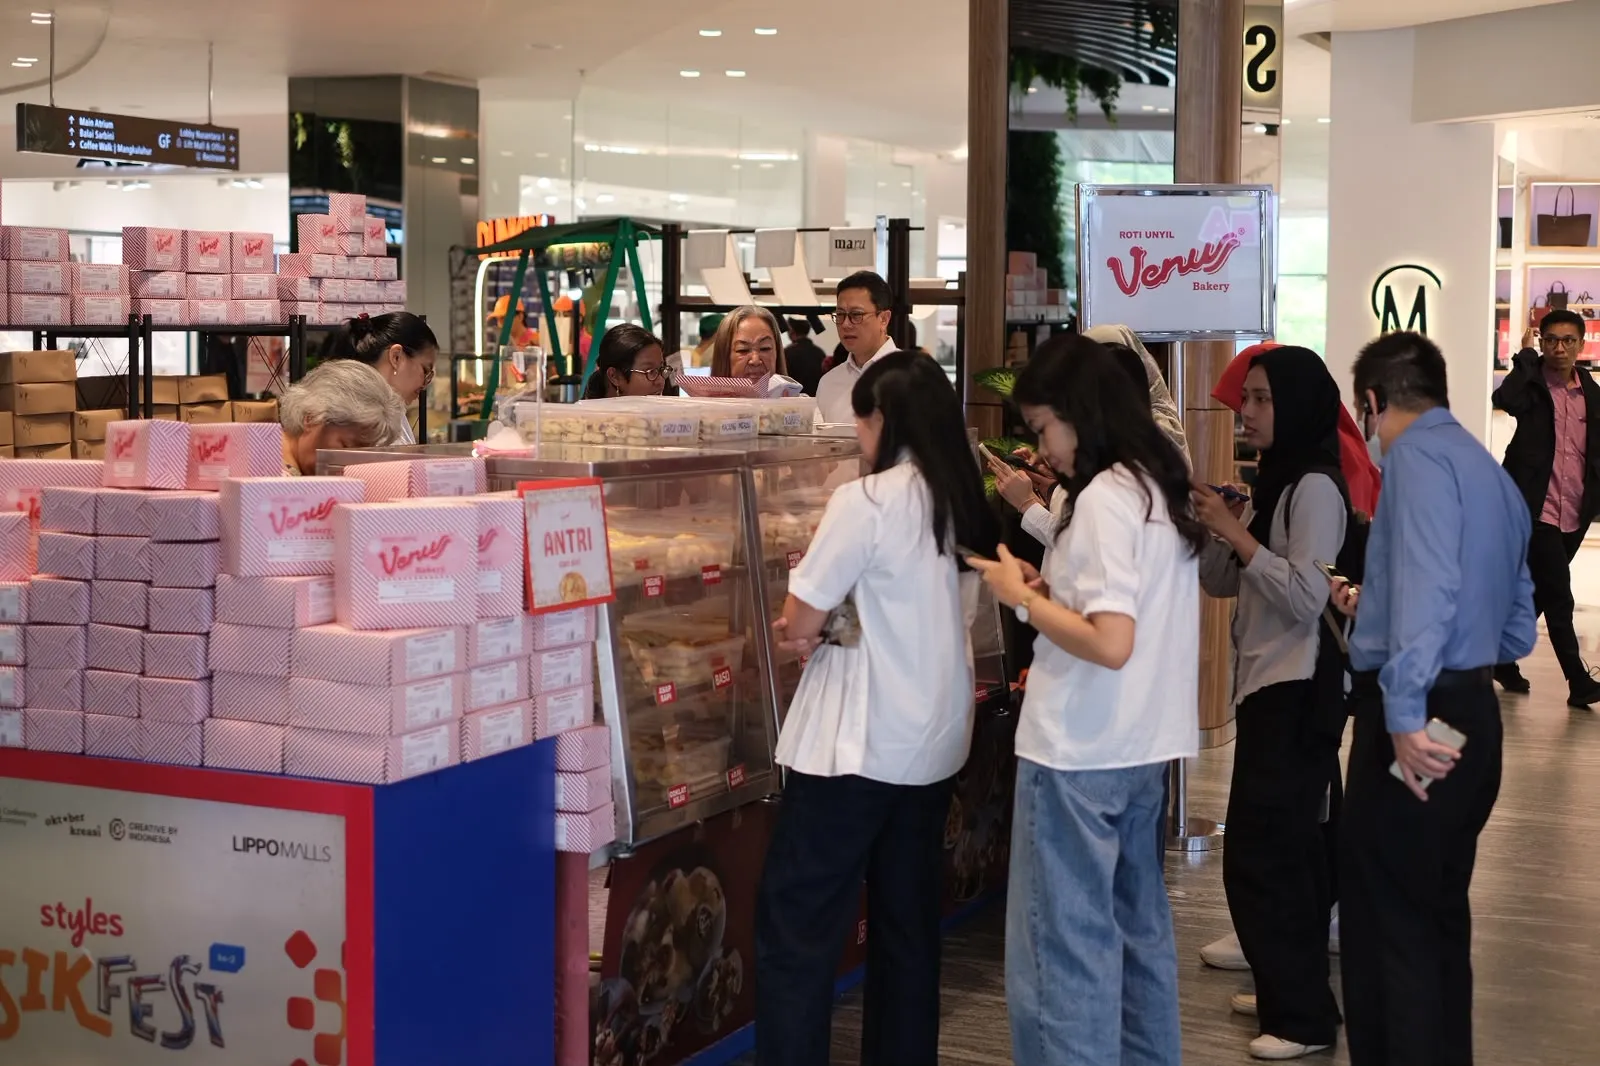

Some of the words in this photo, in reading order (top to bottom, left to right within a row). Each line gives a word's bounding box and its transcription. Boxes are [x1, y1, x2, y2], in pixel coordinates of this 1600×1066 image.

[79, 116, 94, 127] Main
[95, 119, 114, 129] Atrium
[79, 140, 98, 150] Coffee
[98, 142, 113, 152] Walk
[158, 133, 171, 149] GF
[1119, 230, 1142, 239] ROTI
[1145, 230, 1175, 239] UNYIL
[835, 239, 866, 250] maru
[1192, 281, 1230, 293] Bakery
[544, 527, 592, 557] ANTRI
[379, 535, 451, 575] Venus
[69, 824, 102, 838] kreasi
[128, 822, 166, 834] CREATIVE
[167, 827, 178, 836] BY
[128, 832, 172, 844] INDONESIA
[40, 897, 124, 948] styles
